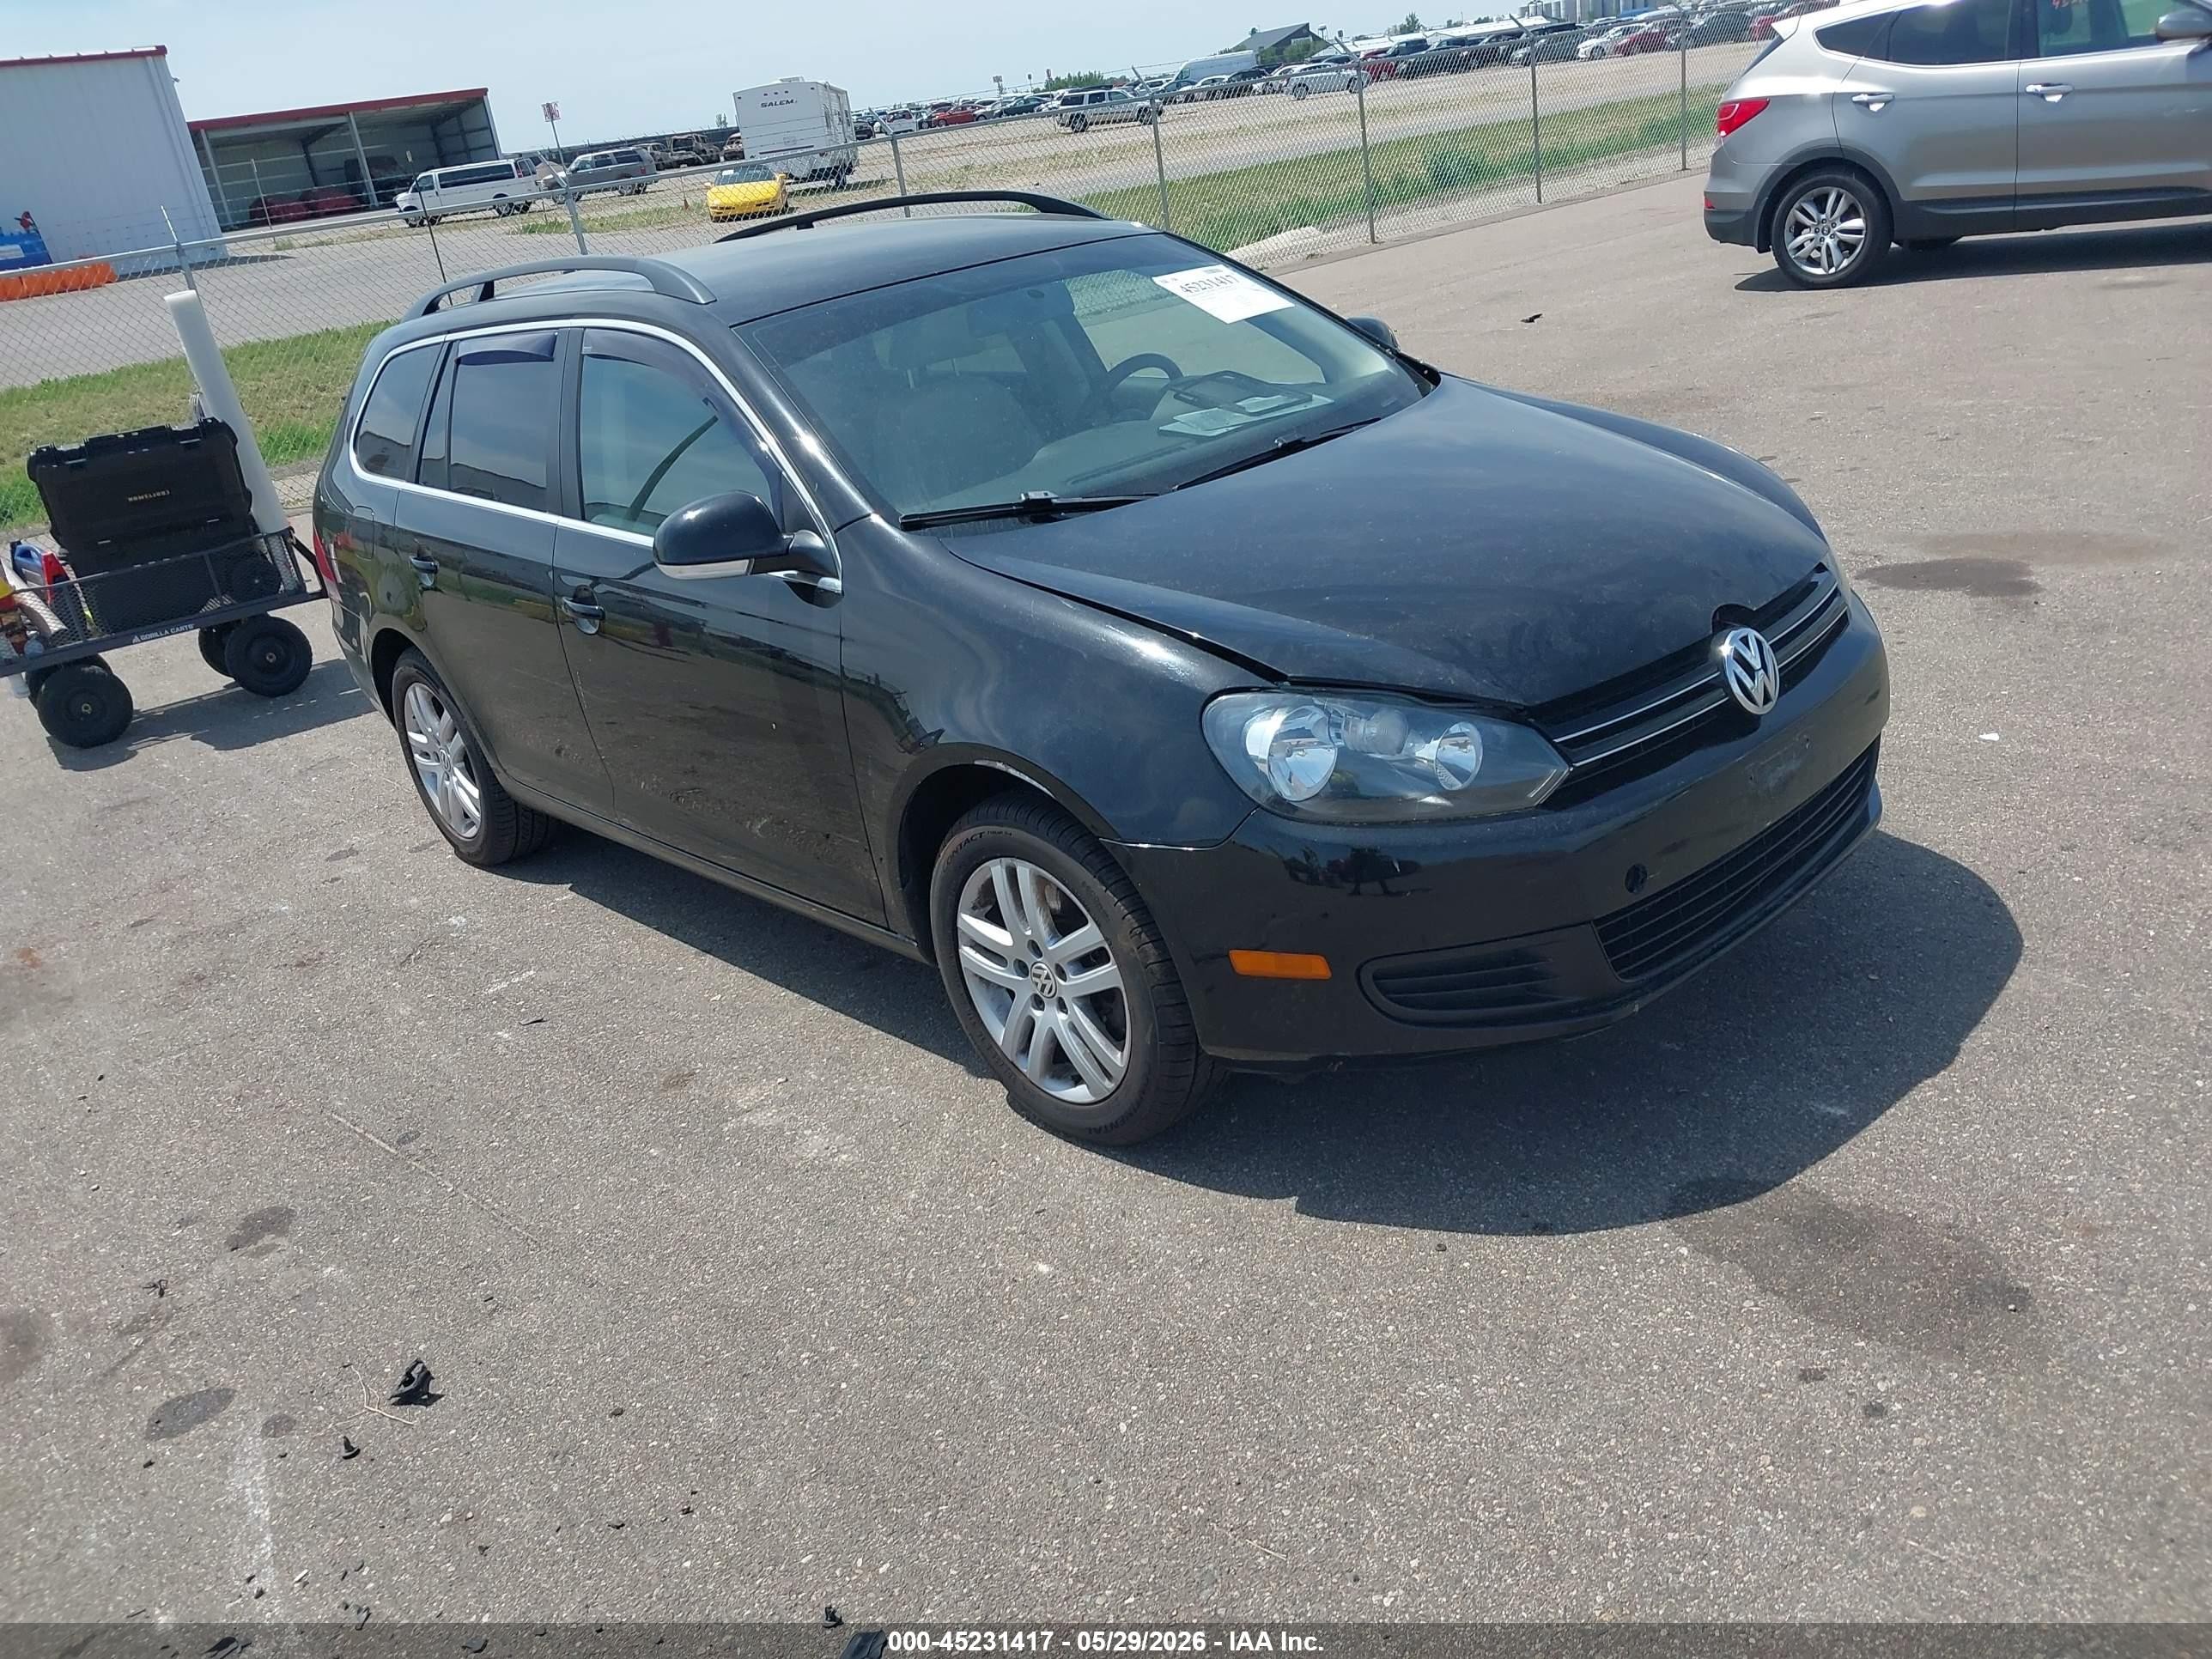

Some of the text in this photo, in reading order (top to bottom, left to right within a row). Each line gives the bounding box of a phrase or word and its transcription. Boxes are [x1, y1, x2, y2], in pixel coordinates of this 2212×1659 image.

[760, 99, 793, 107] SALEM
[1179, 274, 1241, 295] 45231417
[140, 629, 170, 641] GORILLA
[943, 831, 985, 872] CONTACT
